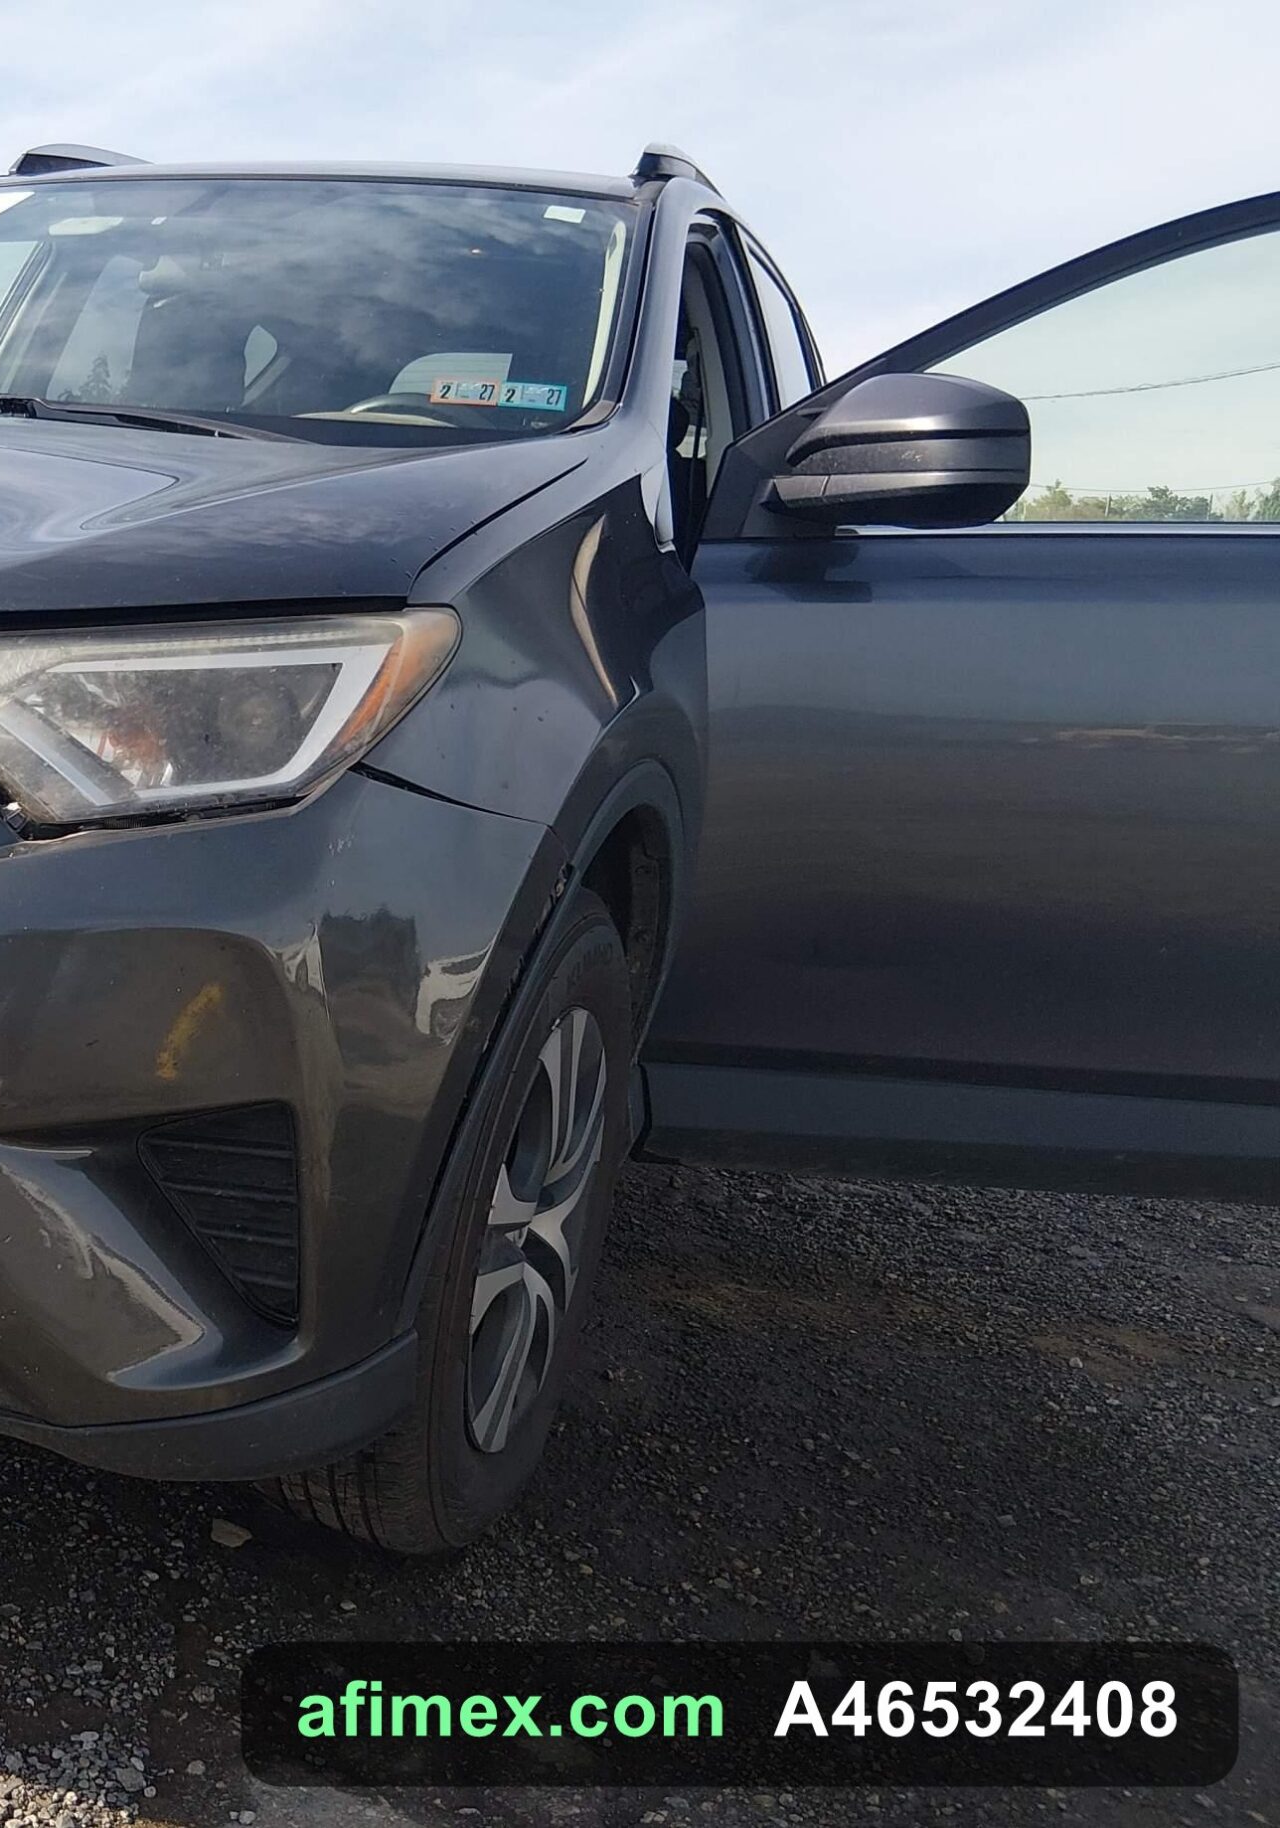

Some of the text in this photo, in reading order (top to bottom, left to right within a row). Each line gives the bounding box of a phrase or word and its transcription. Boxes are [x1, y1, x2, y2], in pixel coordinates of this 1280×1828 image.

[440, 384, 495, 401] 2 27
[505, 388, 562, 406] 2 27
